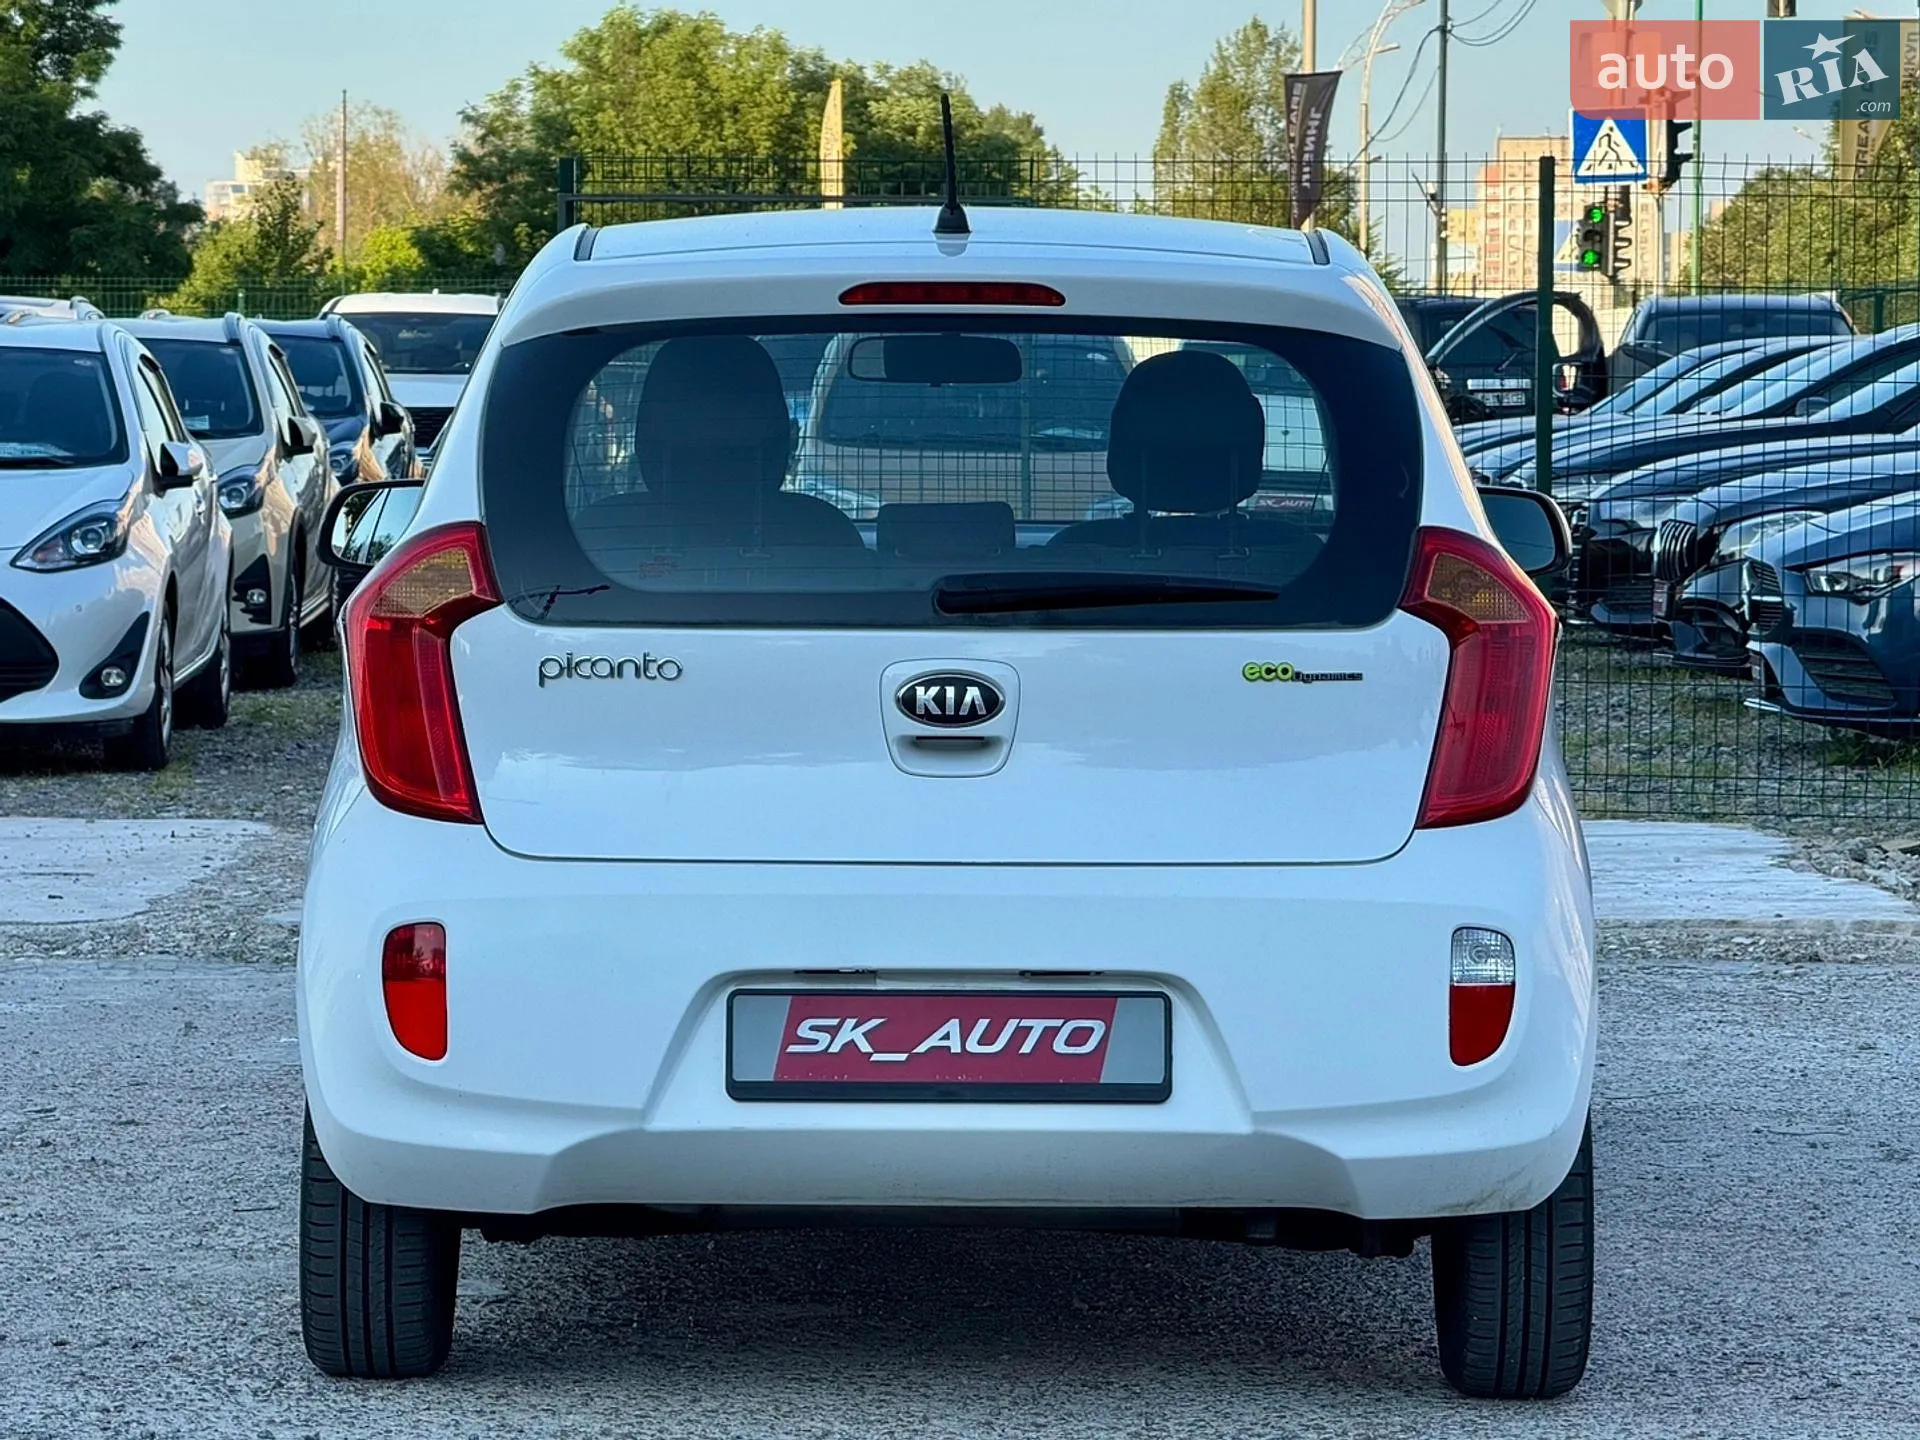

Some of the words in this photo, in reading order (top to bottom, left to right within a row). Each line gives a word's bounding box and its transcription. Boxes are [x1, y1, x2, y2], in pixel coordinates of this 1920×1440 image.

[538, 650, 683, 688] picanto
[914, 685, 987, 715] KIA
[786, 1017, 1107, 1062] SK_AUTO
